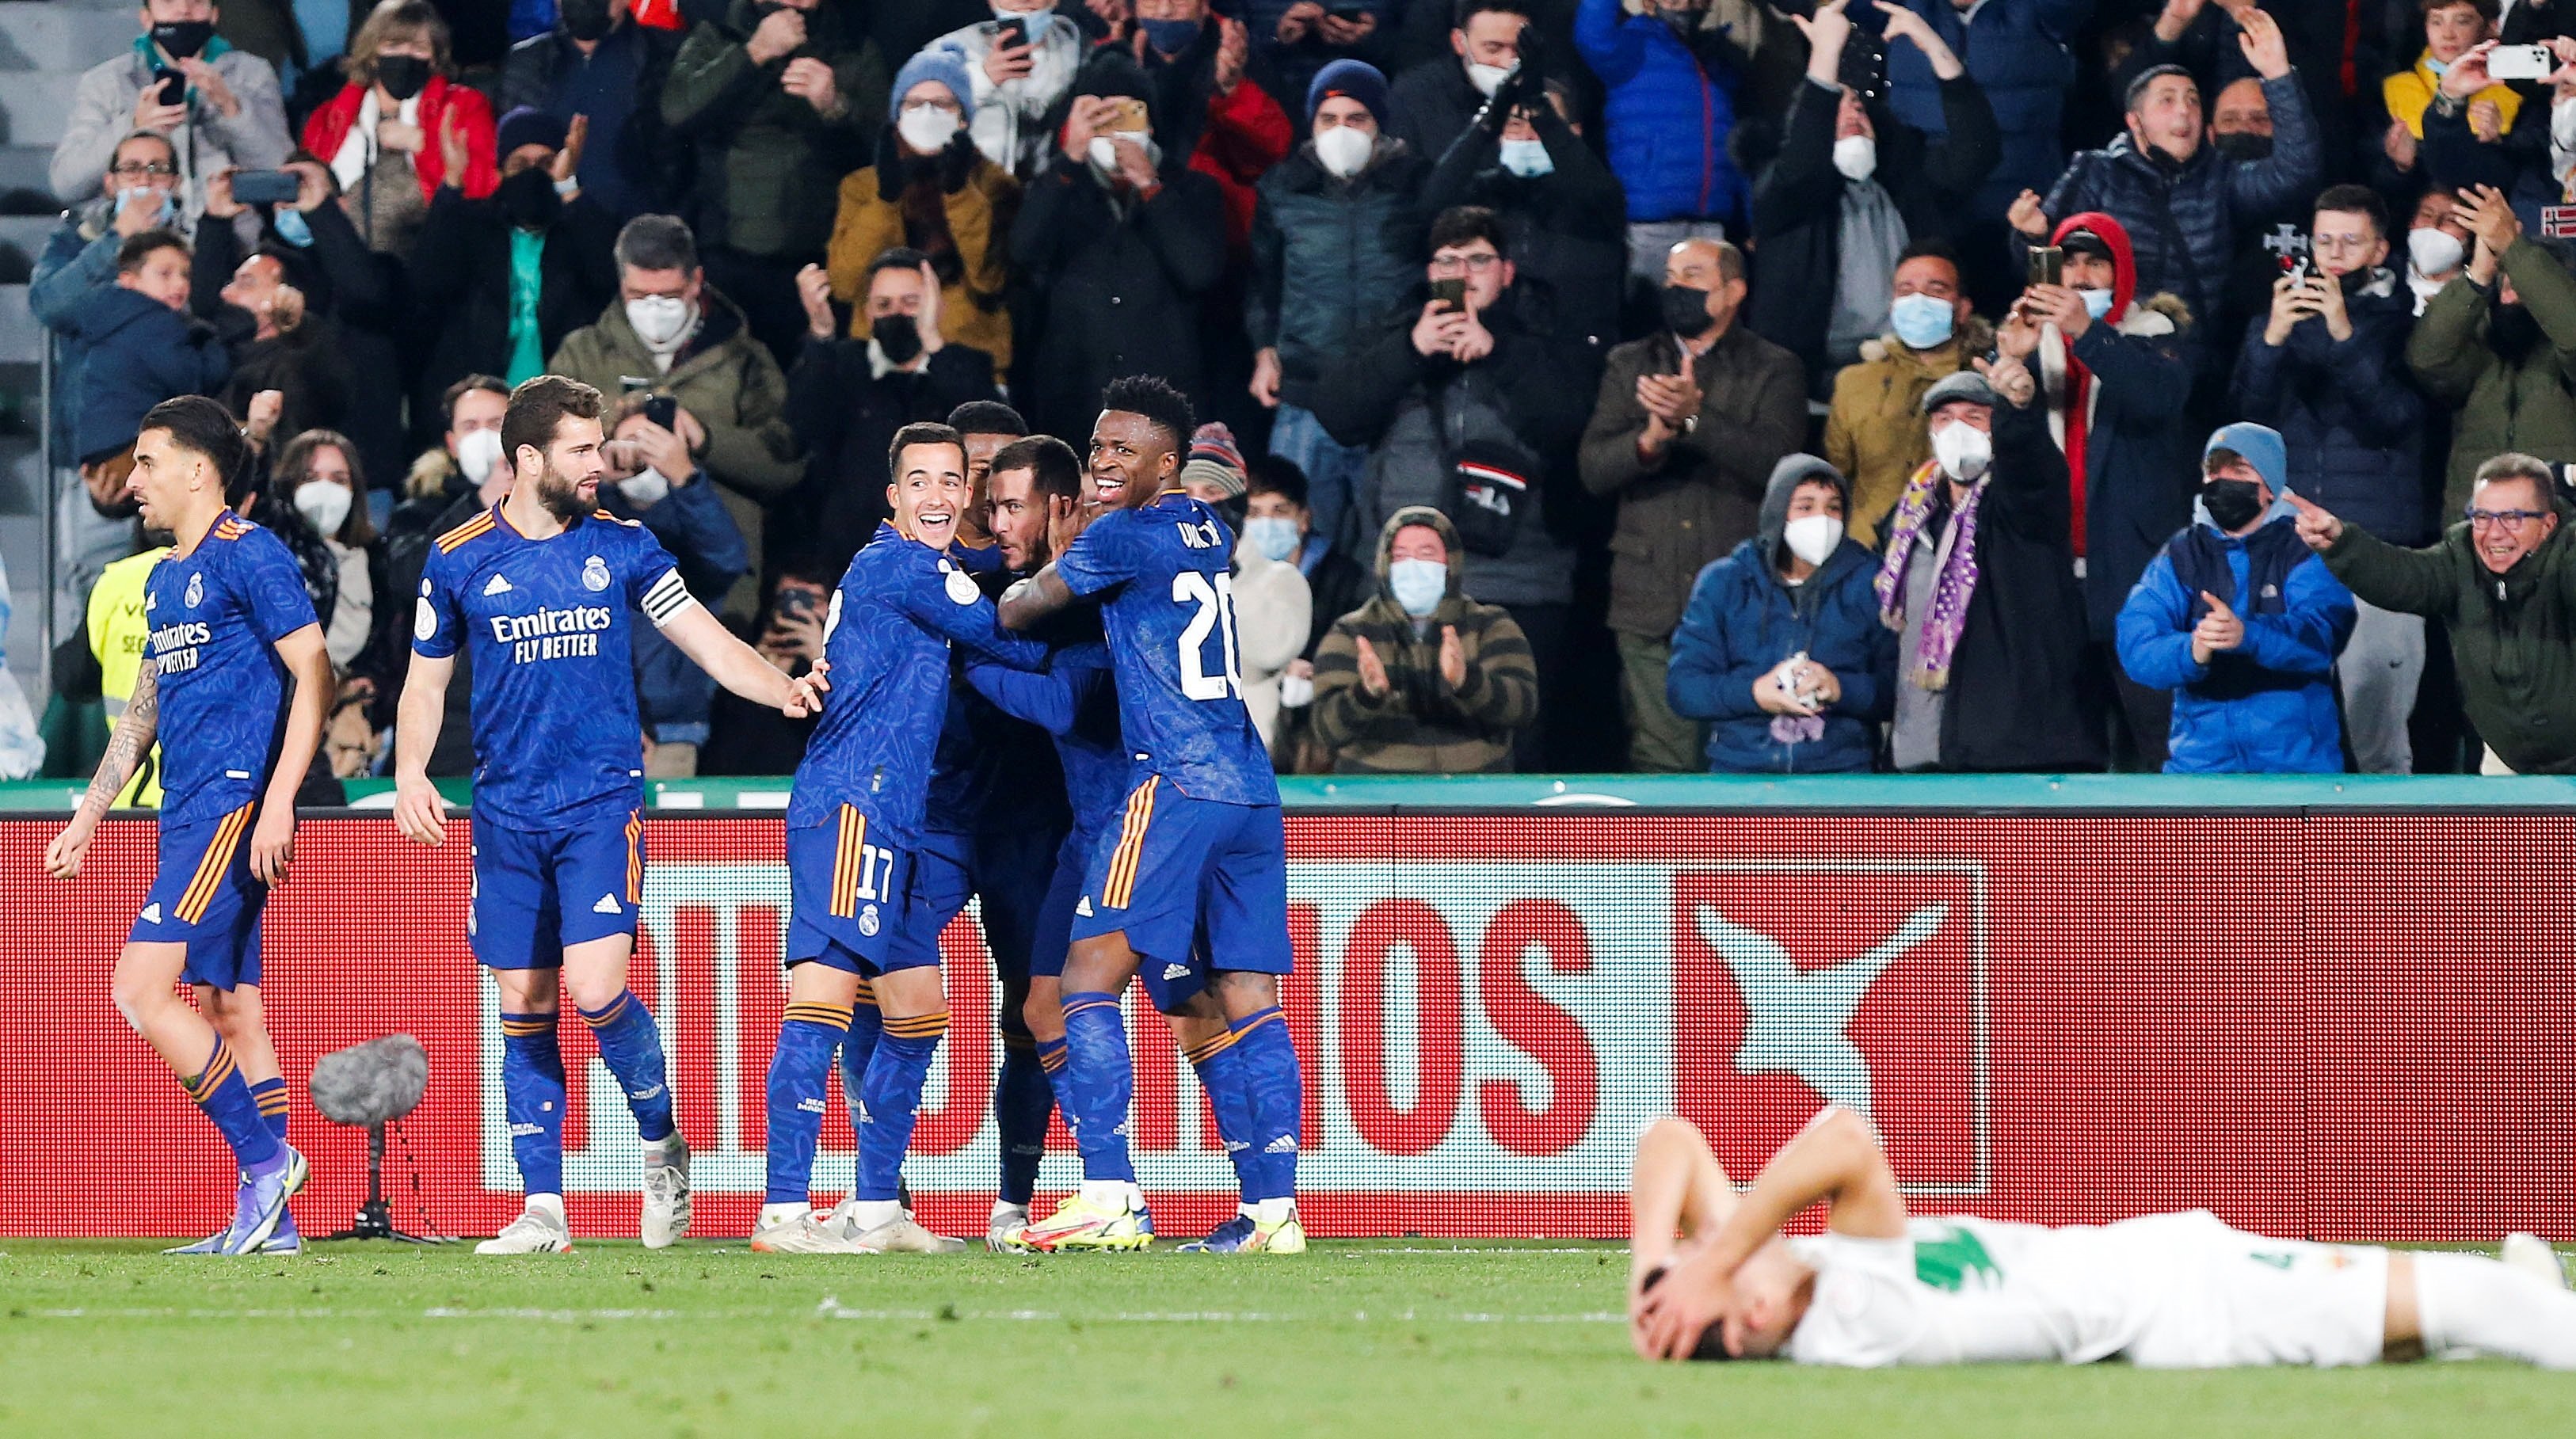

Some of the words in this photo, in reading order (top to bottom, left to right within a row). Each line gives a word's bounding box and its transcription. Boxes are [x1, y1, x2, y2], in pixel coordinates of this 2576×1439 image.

[148, 622, 211, 654] mirates
[490, 604, 611, 643] Emirates
[515, 640, 539, 664] FLY
[542, 634, 597, 660] BETTER
[856, 843, 894, 904] 17
